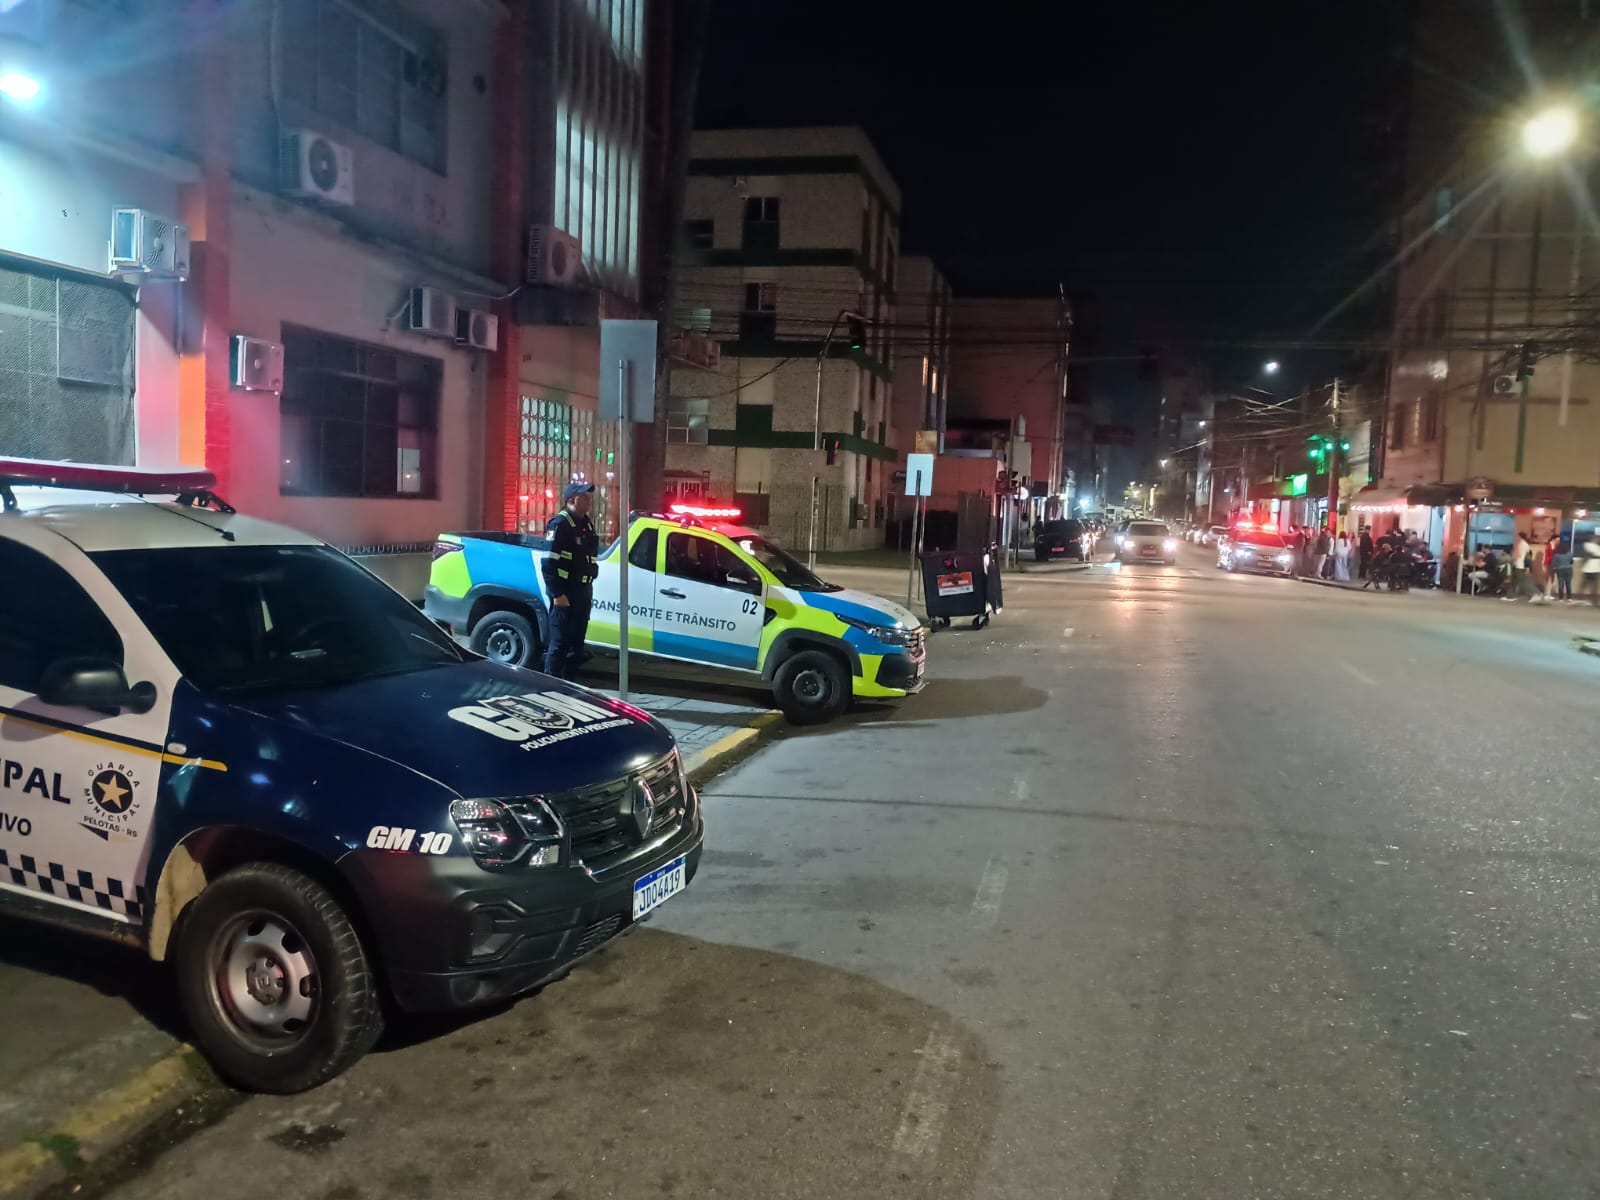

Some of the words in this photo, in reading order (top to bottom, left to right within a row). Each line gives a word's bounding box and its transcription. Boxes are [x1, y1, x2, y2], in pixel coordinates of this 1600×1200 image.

[591, 598, 662, 620] RANSORTE
[665, 611, 673, 622] E
[675, 612, 736, 632] TRÂNSITO
[742, 599, 758, 615] 02
[519, 727, 588, 752] POLICIAMENTO
[0, 757, 71, 805] PAL
[87, 762, 140, 788] GUARDA
[83, 788, 140, 823] MUNICIPAL
[83, 815, 120, 833] PELOTAS
[126, 828, 138, 838] RS
[366, 825, 417, 851] GM
[419, 831, 453, 855] 10
